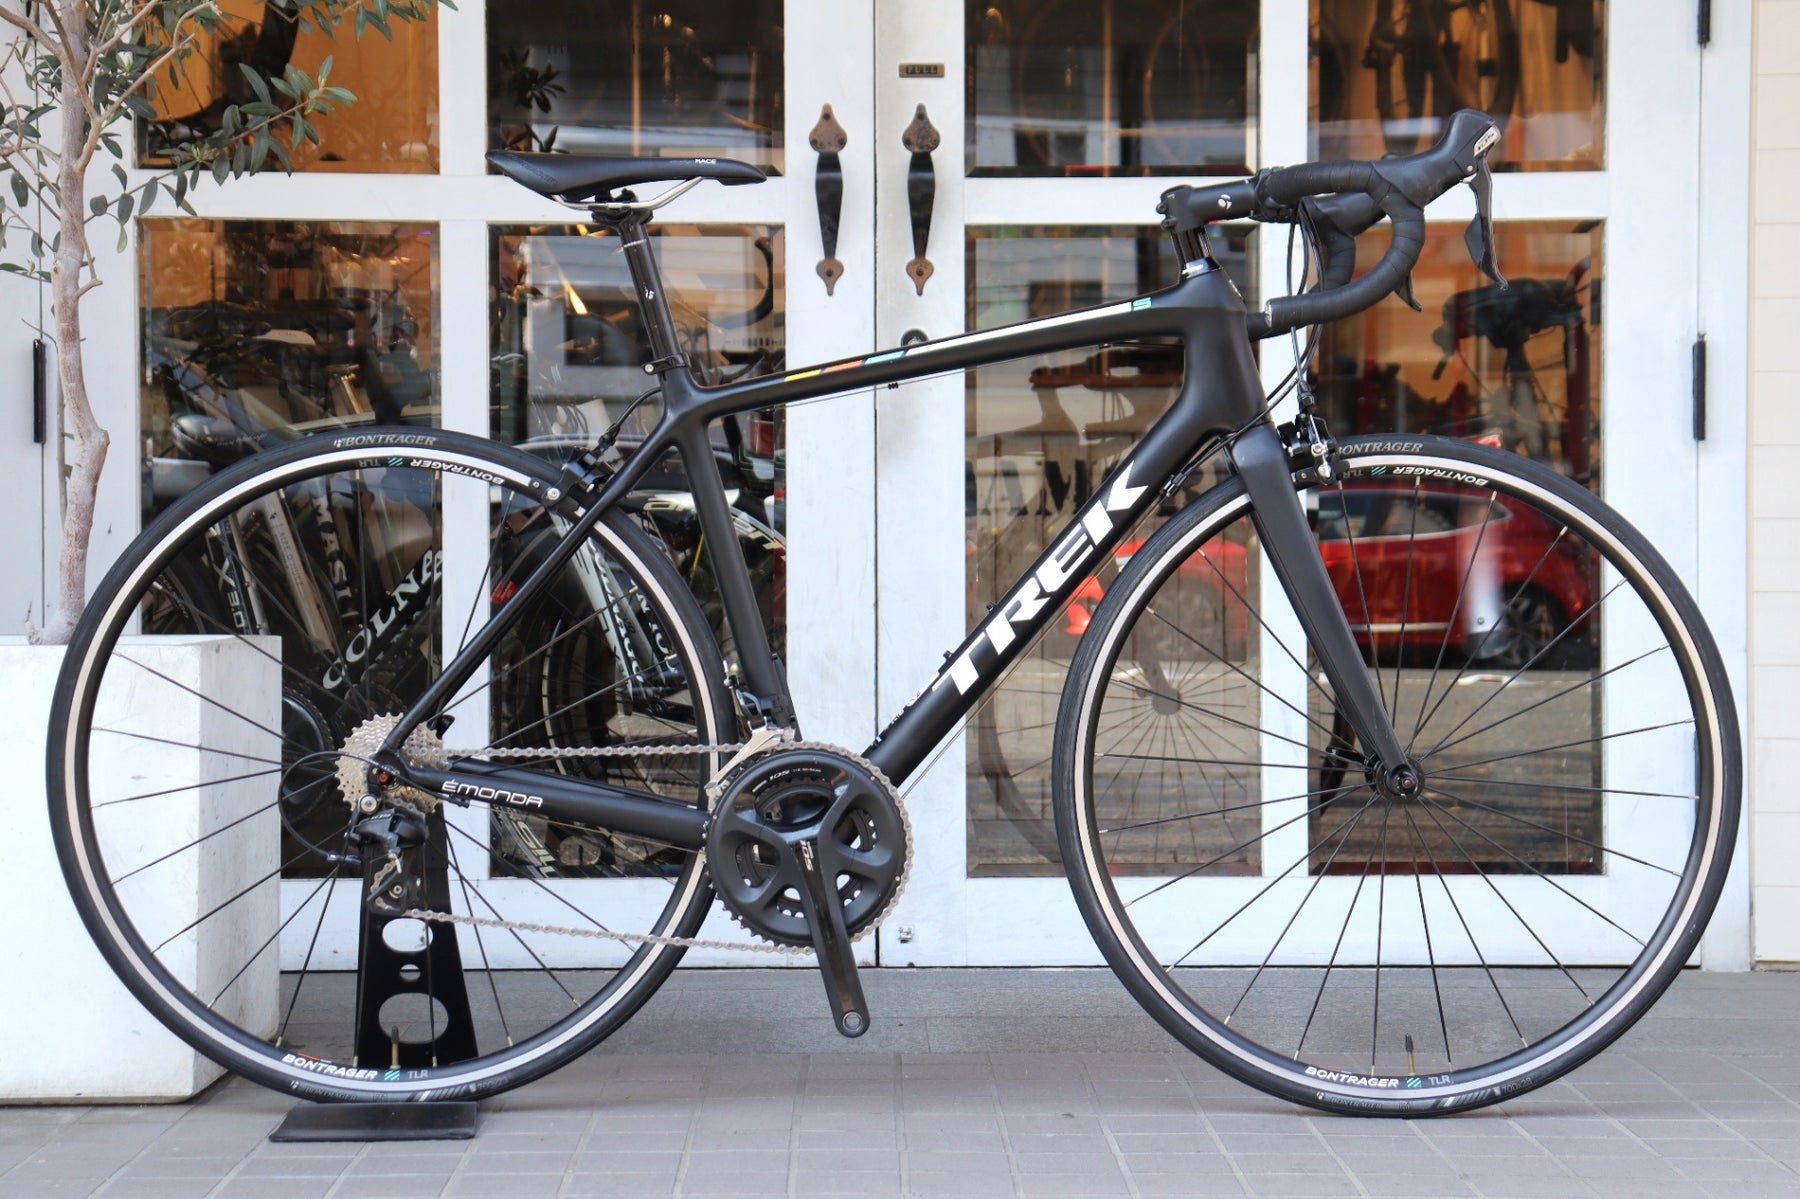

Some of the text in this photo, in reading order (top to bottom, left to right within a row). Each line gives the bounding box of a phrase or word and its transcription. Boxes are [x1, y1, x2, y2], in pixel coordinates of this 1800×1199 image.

[344, 434, 437, 447] BONTRAGER
[410, 458, 505, 485] BONTRAGER
[1392, 466, 1489, 487] BONTRAGER
[932, 460, 1149, 696] TREK
[281, 1053, 429, 1080] BONTRAGER TLR
[1305, 1066, 1451, 1088] BONTRAGER TLR
